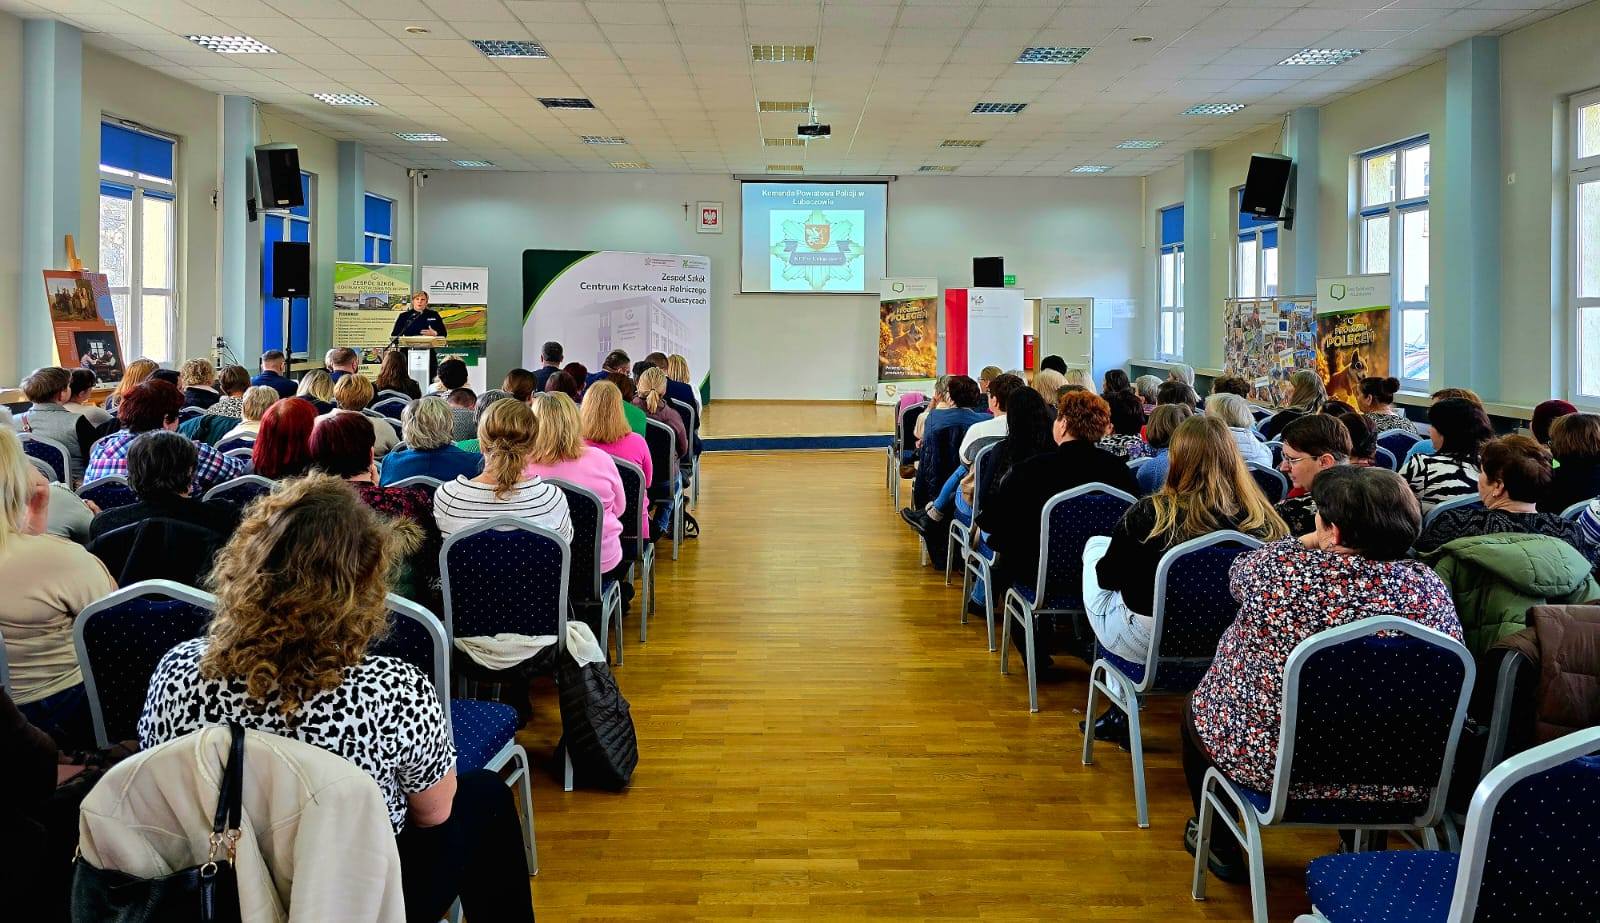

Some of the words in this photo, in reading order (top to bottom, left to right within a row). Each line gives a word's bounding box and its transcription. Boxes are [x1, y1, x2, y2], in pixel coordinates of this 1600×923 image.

[446, 281, 479, 290] ARiMR
[580, 282, 620, 291] Centrum
[622, 283, 668, 293] Kształcenia
